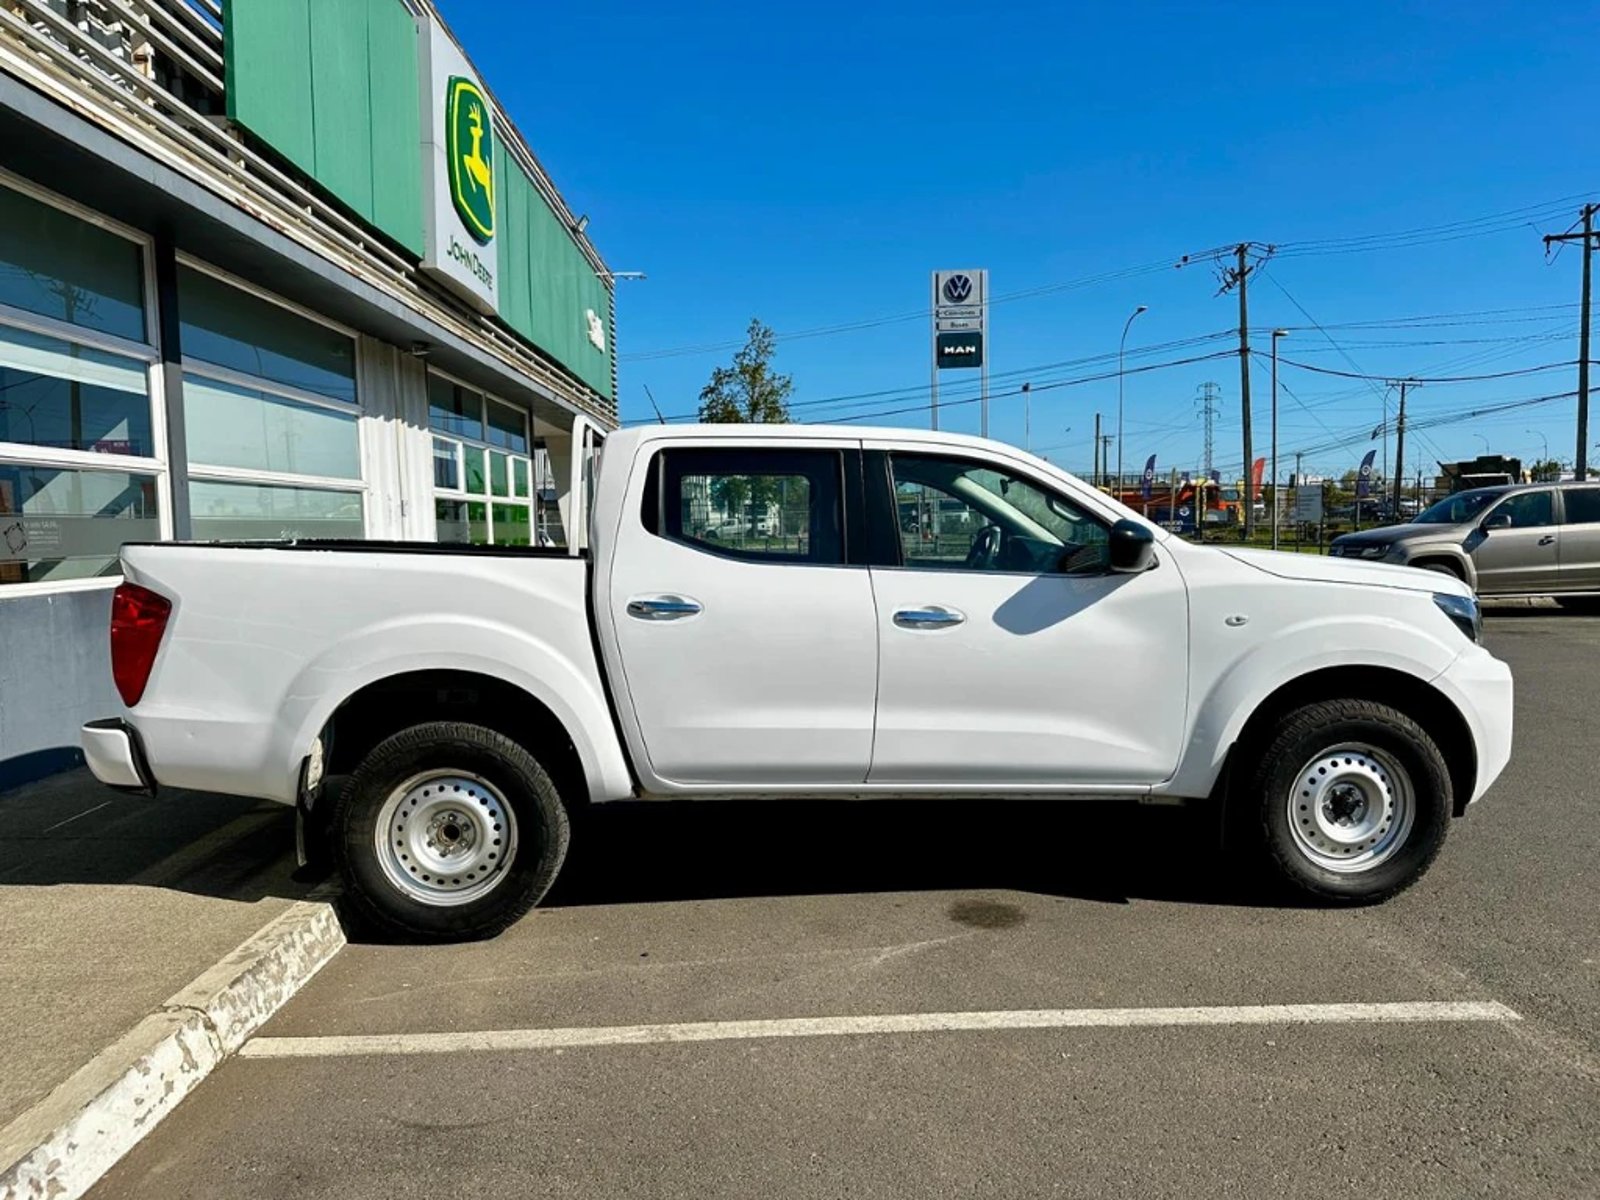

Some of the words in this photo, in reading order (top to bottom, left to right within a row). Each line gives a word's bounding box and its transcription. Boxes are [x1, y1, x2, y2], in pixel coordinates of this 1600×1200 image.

[446, 234, 473, 271] JOHN
[473, 253, 493, 291] DEERE
[943, 345, 976, 354] MAN
